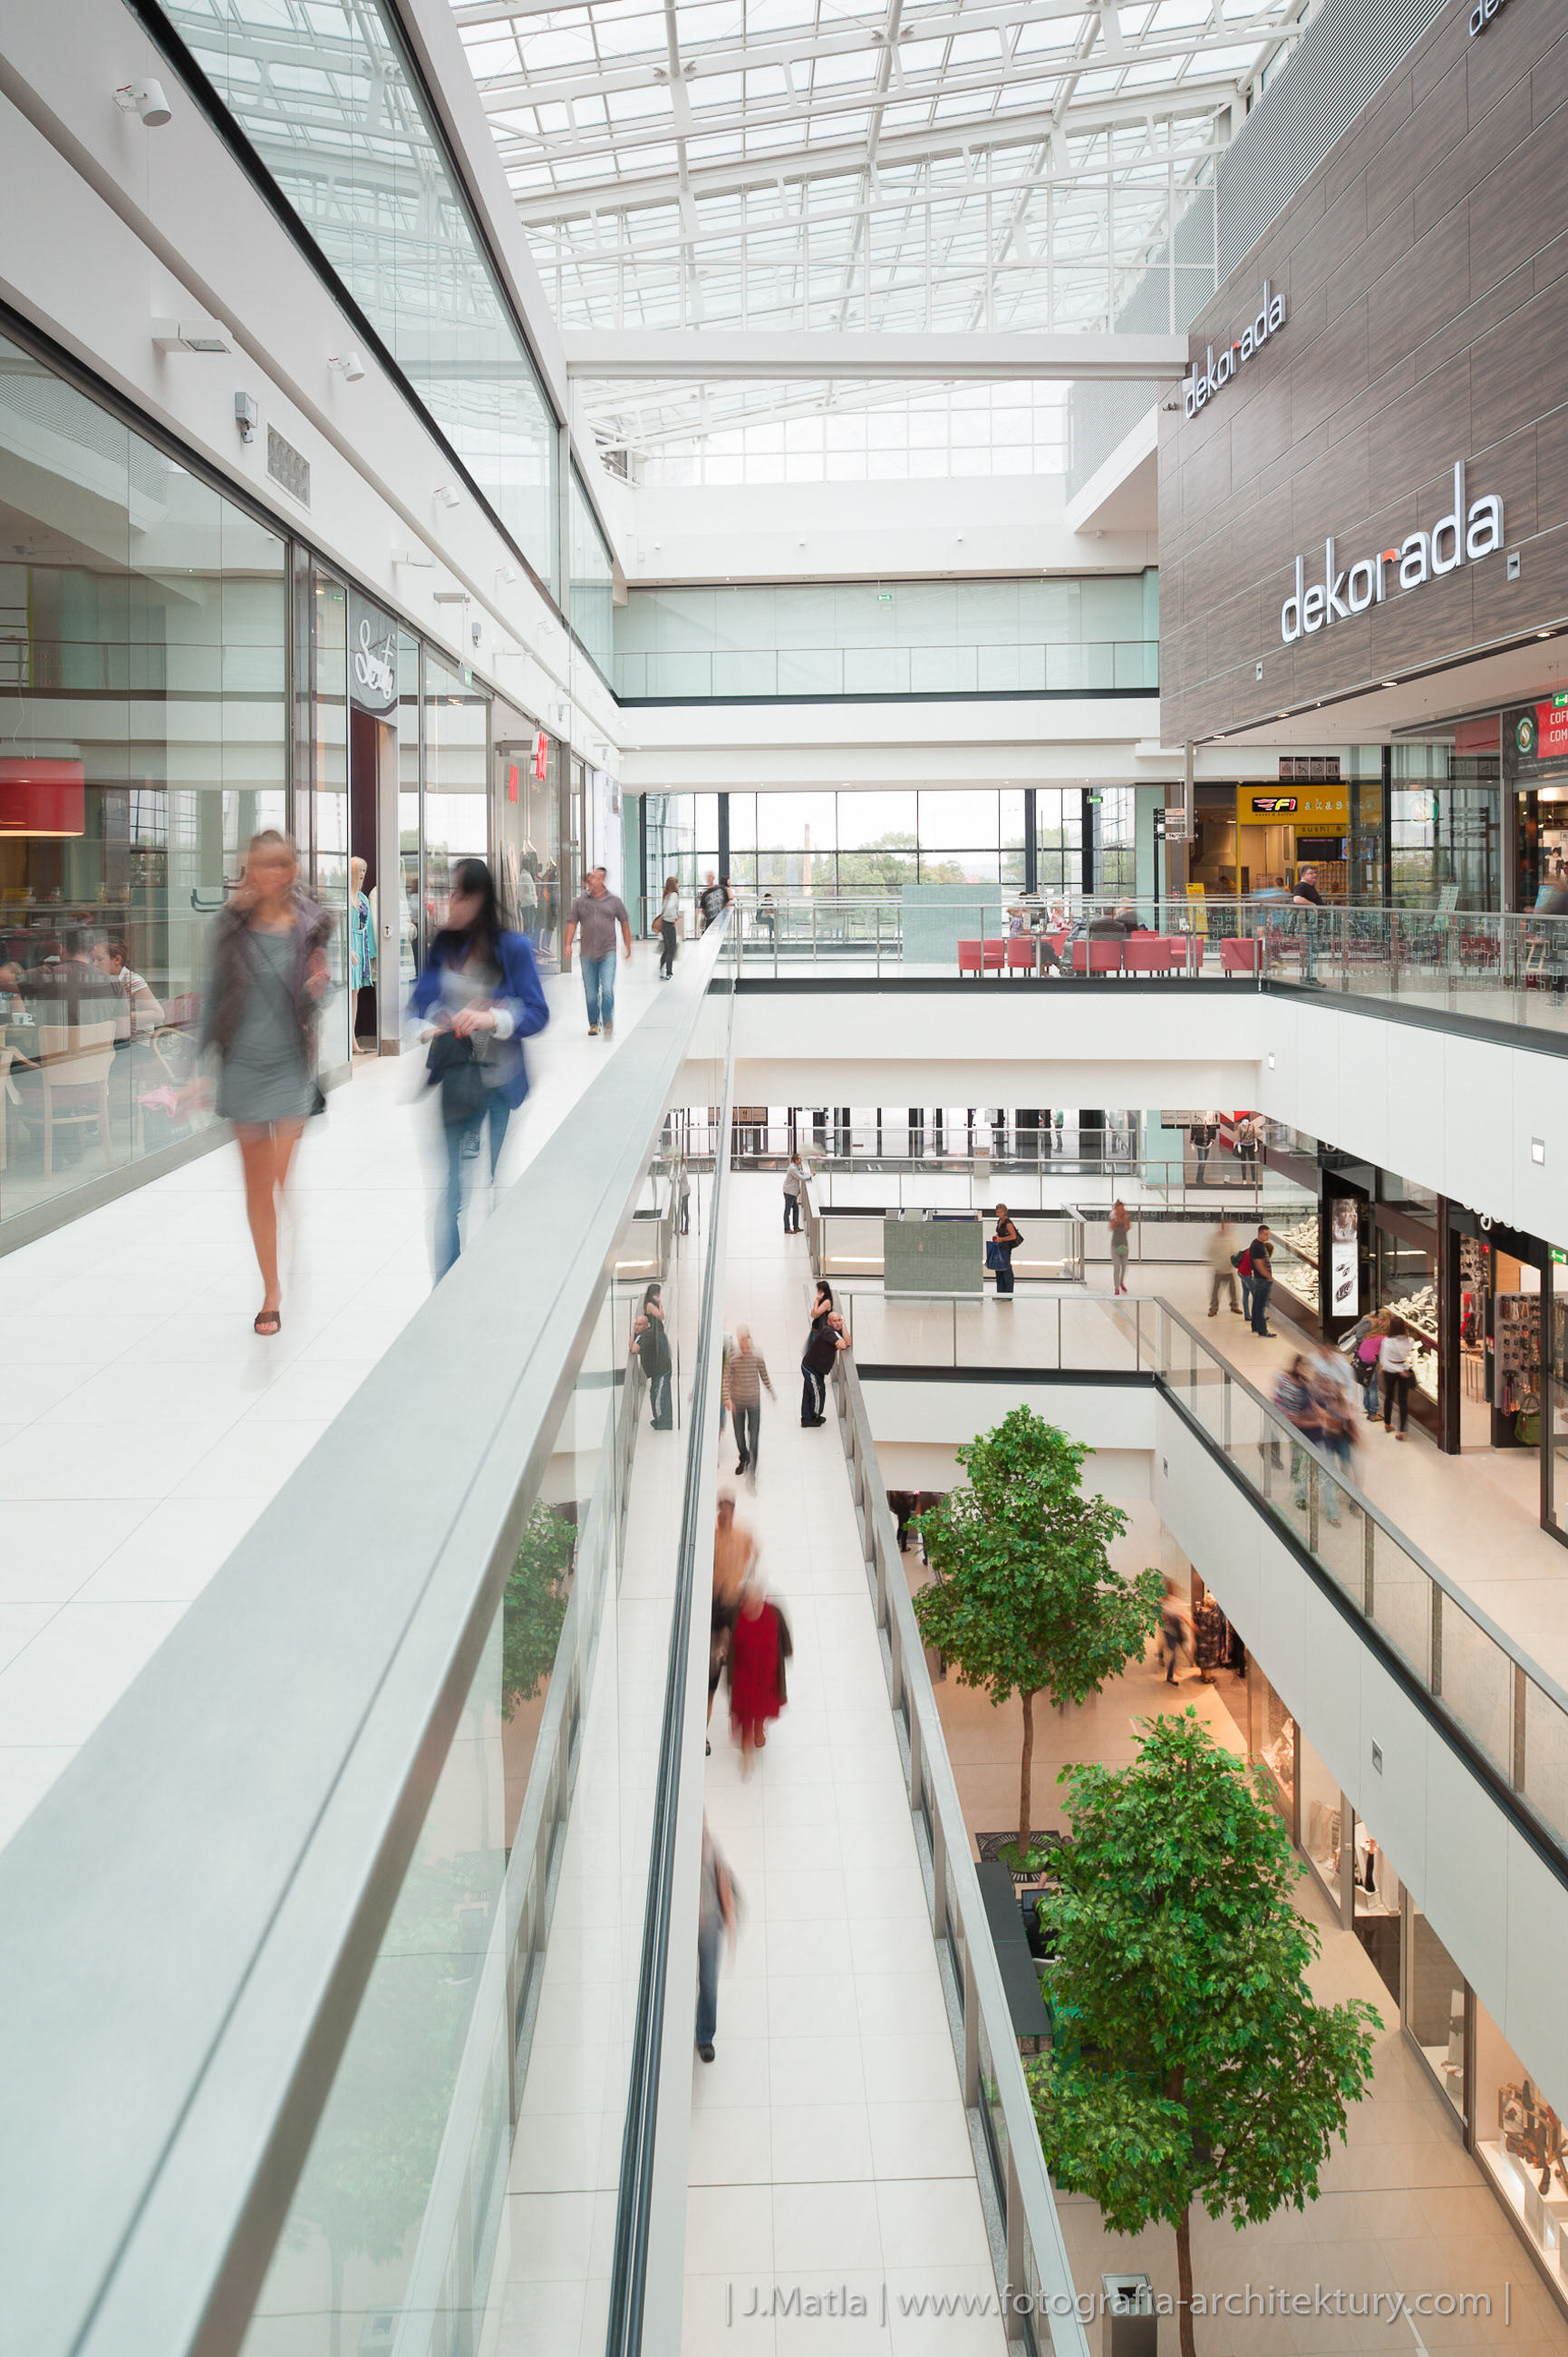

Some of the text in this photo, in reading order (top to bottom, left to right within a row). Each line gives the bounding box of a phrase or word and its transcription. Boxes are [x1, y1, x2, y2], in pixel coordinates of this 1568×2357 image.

[1469, 0, 1505, 37] de
[1185, 280, 1285, 419] dekorada
[1281, 460, 1504, 643] dekorada
[1550, 710, 1568, 725] COF
